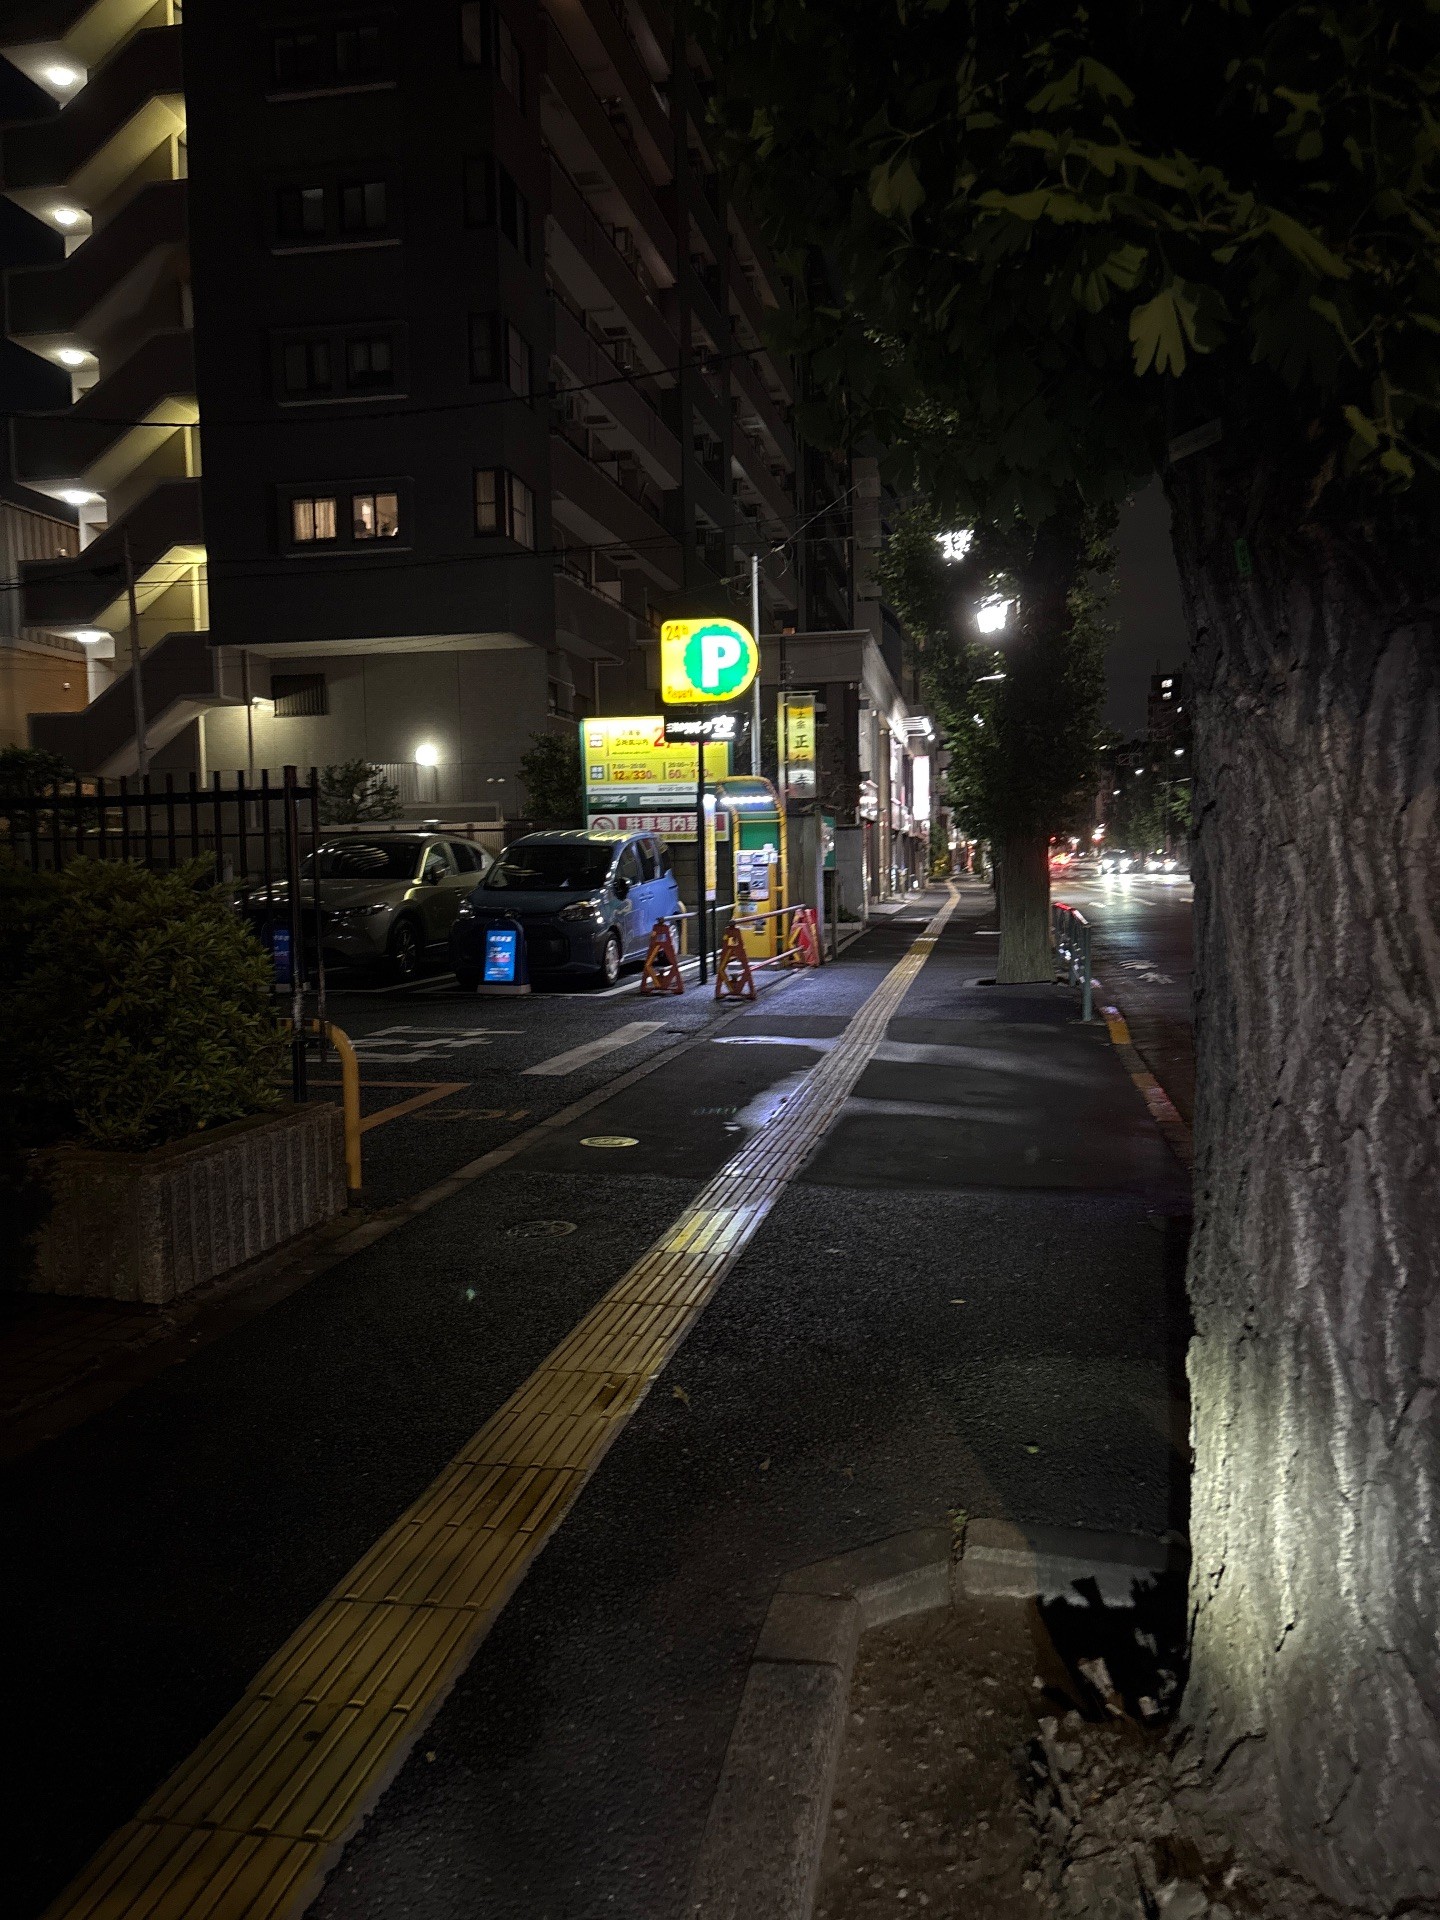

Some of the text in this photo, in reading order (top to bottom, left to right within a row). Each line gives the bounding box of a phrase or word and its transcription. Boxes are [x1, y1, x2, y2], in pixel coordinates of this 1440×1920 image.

[701, 635, 741, 688] P
[625, 815, 717, 832] 駐車場内禁
